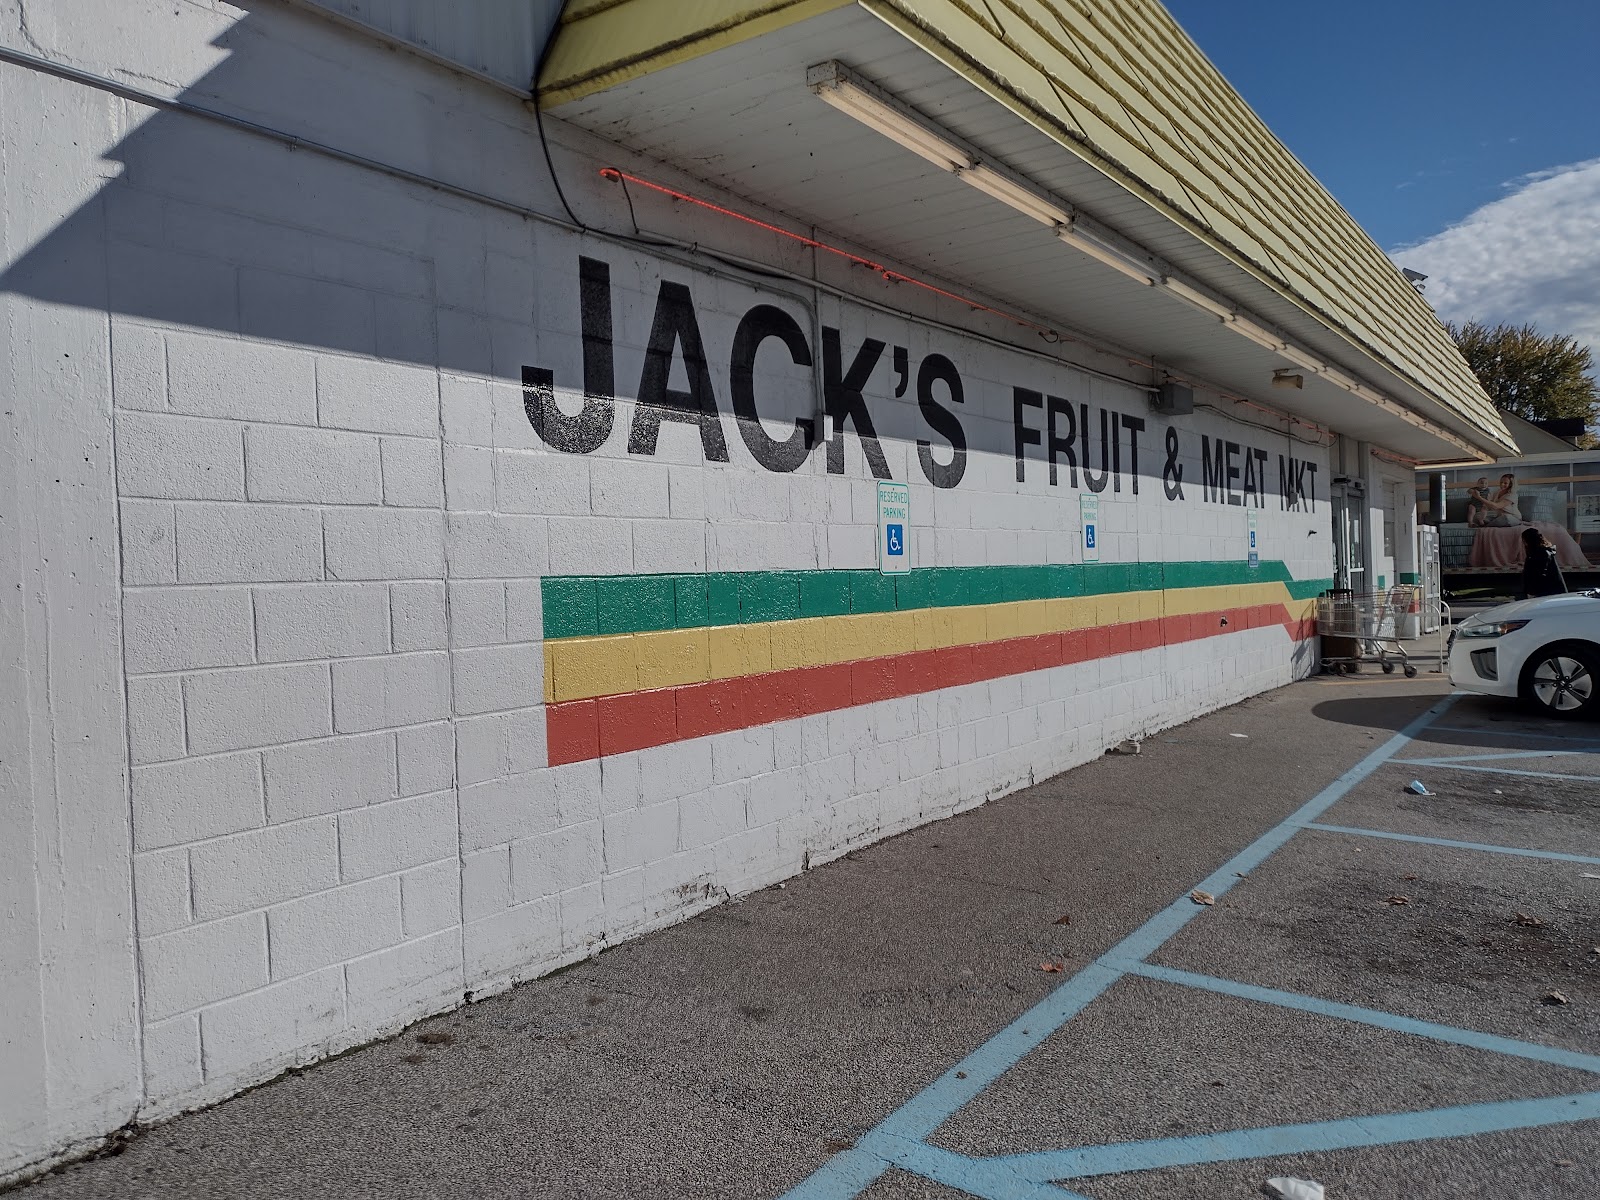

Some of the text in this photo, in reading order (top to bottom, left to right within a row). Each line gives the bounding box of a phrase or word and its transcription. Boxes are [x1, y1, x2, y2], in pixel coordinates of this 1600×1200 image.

[521, 255, 1317, 513] JACK'S FRUIT & MEAT MKT
[880, 490, 908, 504] RESERVED
[883, 507, 906, 519] PARKING
